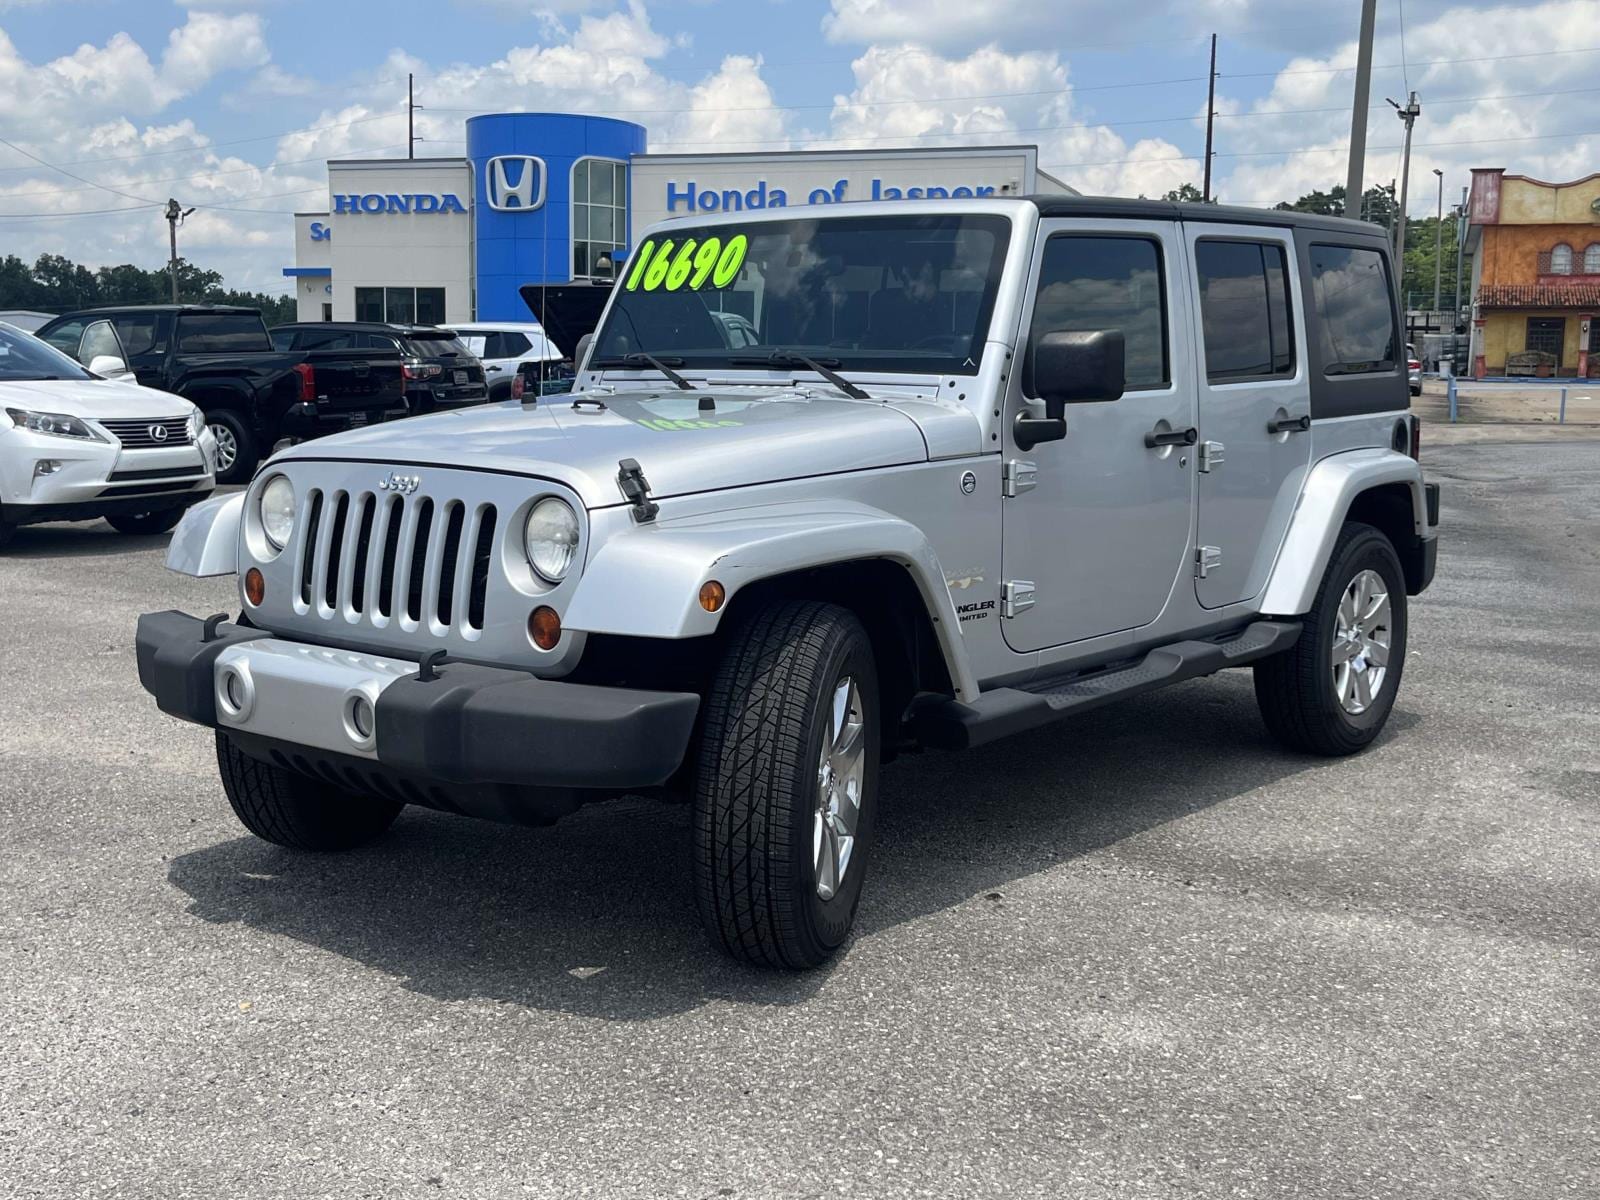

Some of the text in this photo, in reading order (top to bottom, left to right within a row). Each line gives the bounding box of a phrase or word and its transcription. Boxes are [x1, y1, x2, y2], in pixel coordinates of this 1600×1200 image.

[333, 194, 468, 214] HONDA
[667, 180, 787, 213] Honda
[808, 179, 849, 205] of
[626, 234, 748, 292] 16690
[379, 471, 420, 496] Jeep
[956, 600, 995, 614] NGLER
[959, 612, 988, 622] IMITED
